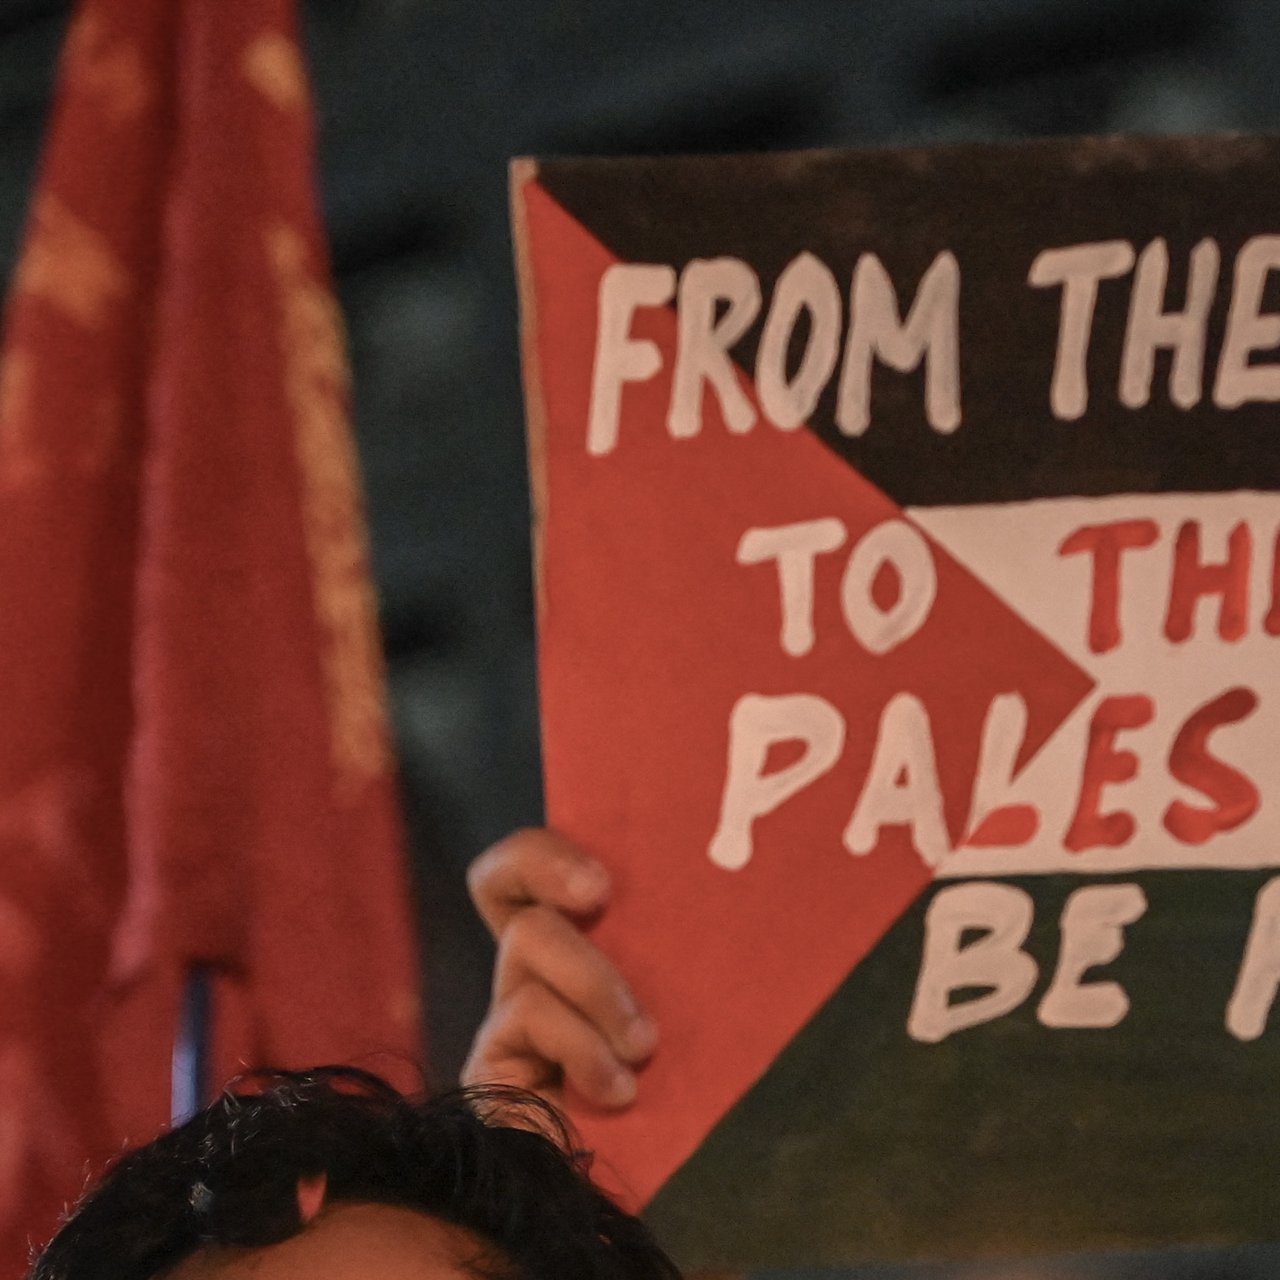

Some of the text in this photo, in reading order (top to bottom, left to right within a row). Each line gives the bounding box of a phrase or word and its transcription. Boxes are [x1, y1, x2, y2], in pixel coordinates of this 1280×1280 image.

[585, 251, 961, 456] FROM
[736, 517, 936, 656] TO
[907, 881, 1147, 1043] BE
